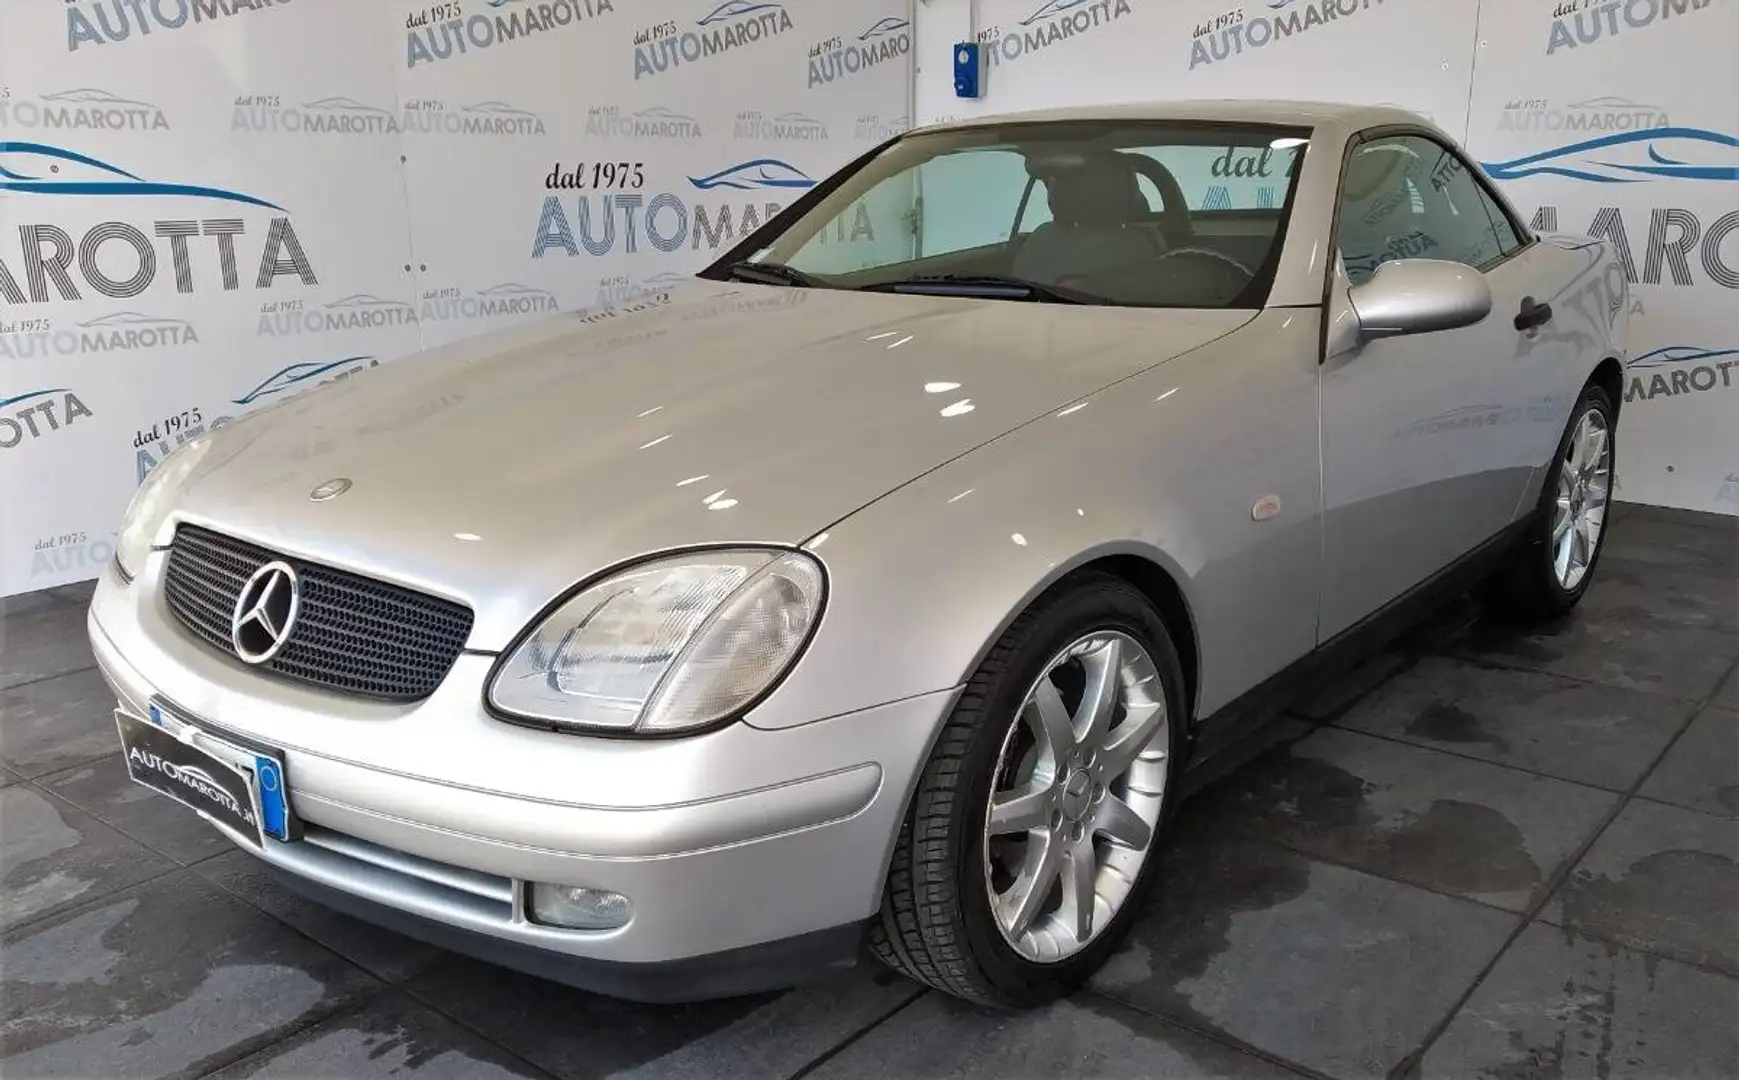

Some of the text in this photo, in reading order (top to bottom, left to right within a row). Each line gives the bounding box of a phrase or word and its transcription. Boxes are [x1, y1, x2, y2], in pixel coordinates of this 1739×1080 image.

[405, 1, 462, 29] dal 1975
[1192, 9, 1244, 38] dal 1975
[407, 0, 614, 68] AUTOMAROTTA
[633, 20, 677, 46] dal 1975
[634, 9, 793, 80] AUTOMAROTTA
[808, 33, 910, 89] AUTOMARO
[256, 95, 280, 107] 1975
[422, 100, 443, 110] 1975
[1504, 99, 1548, 110] dal 1975
[231, 107, 400, 134] AUTOMAROTTA
[401, 111, 546, 136] AUTOMAROTTA
[585, 115, 702, 139] AUTOMAROTTA
[733, 120, 829, 141] AUTOMAROTTA
[1495, 109, 1670, 133] AUTOMAROTTA
[1211, 146, 1274, 178] dal
[545, 162, 645, 189] dal 1975
[280, 300, 303, 312] 1975
[440, 288, 461, 298] 1975
[420, 296, 559, 322] AUTOMAROTTA
[20, 318, 50, 332] 1975
[257, 308, 418, 337] AUTOMAROTTA
[133, 408, 201, 448] dal 1975
[34, 532, 87, 551] dal 1975
